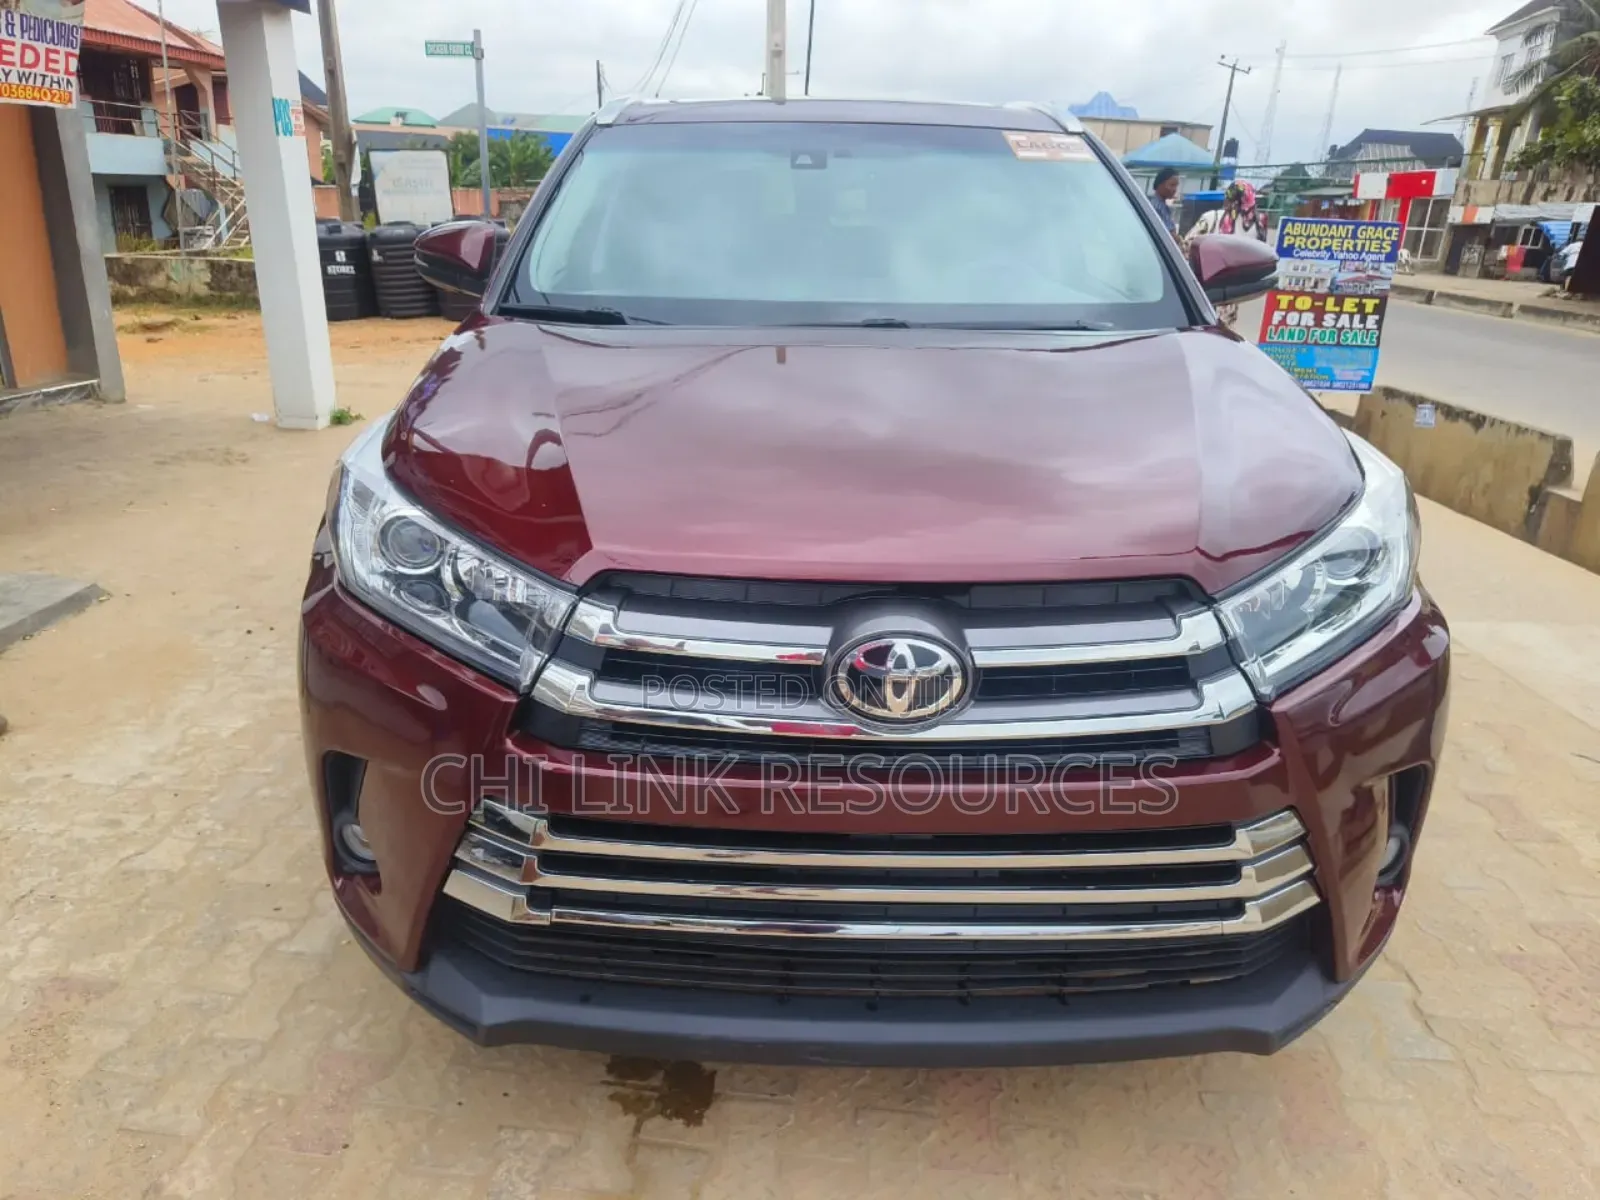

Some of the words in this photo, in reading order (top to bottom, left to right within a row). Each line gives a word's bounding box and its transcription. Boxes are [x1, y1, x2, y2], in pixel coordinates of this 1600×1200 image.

[5, 9, 16, 37] &
[1283, 222, 1355, 239] ABUNDANT
[1357, 226, 1400, 240] GRACE
[1283, 235, 1392, 253] PROPERTIES
[1292, 249, 1331, 260] Celebrity
[1332, 251, 1359, 260] Yahoo
[1359, 252, 1386, 261] Agent
[1276, 294, 1380, 314] TO-LET
[1272, 310, 1315, 327] FOR
[1322, 313, 1380, 329] SALE
[1267, 326, 1306, 343] LAND
[1308, 327, 1338, 344] FOR
[1340, 329, 1379, 346] SALE
